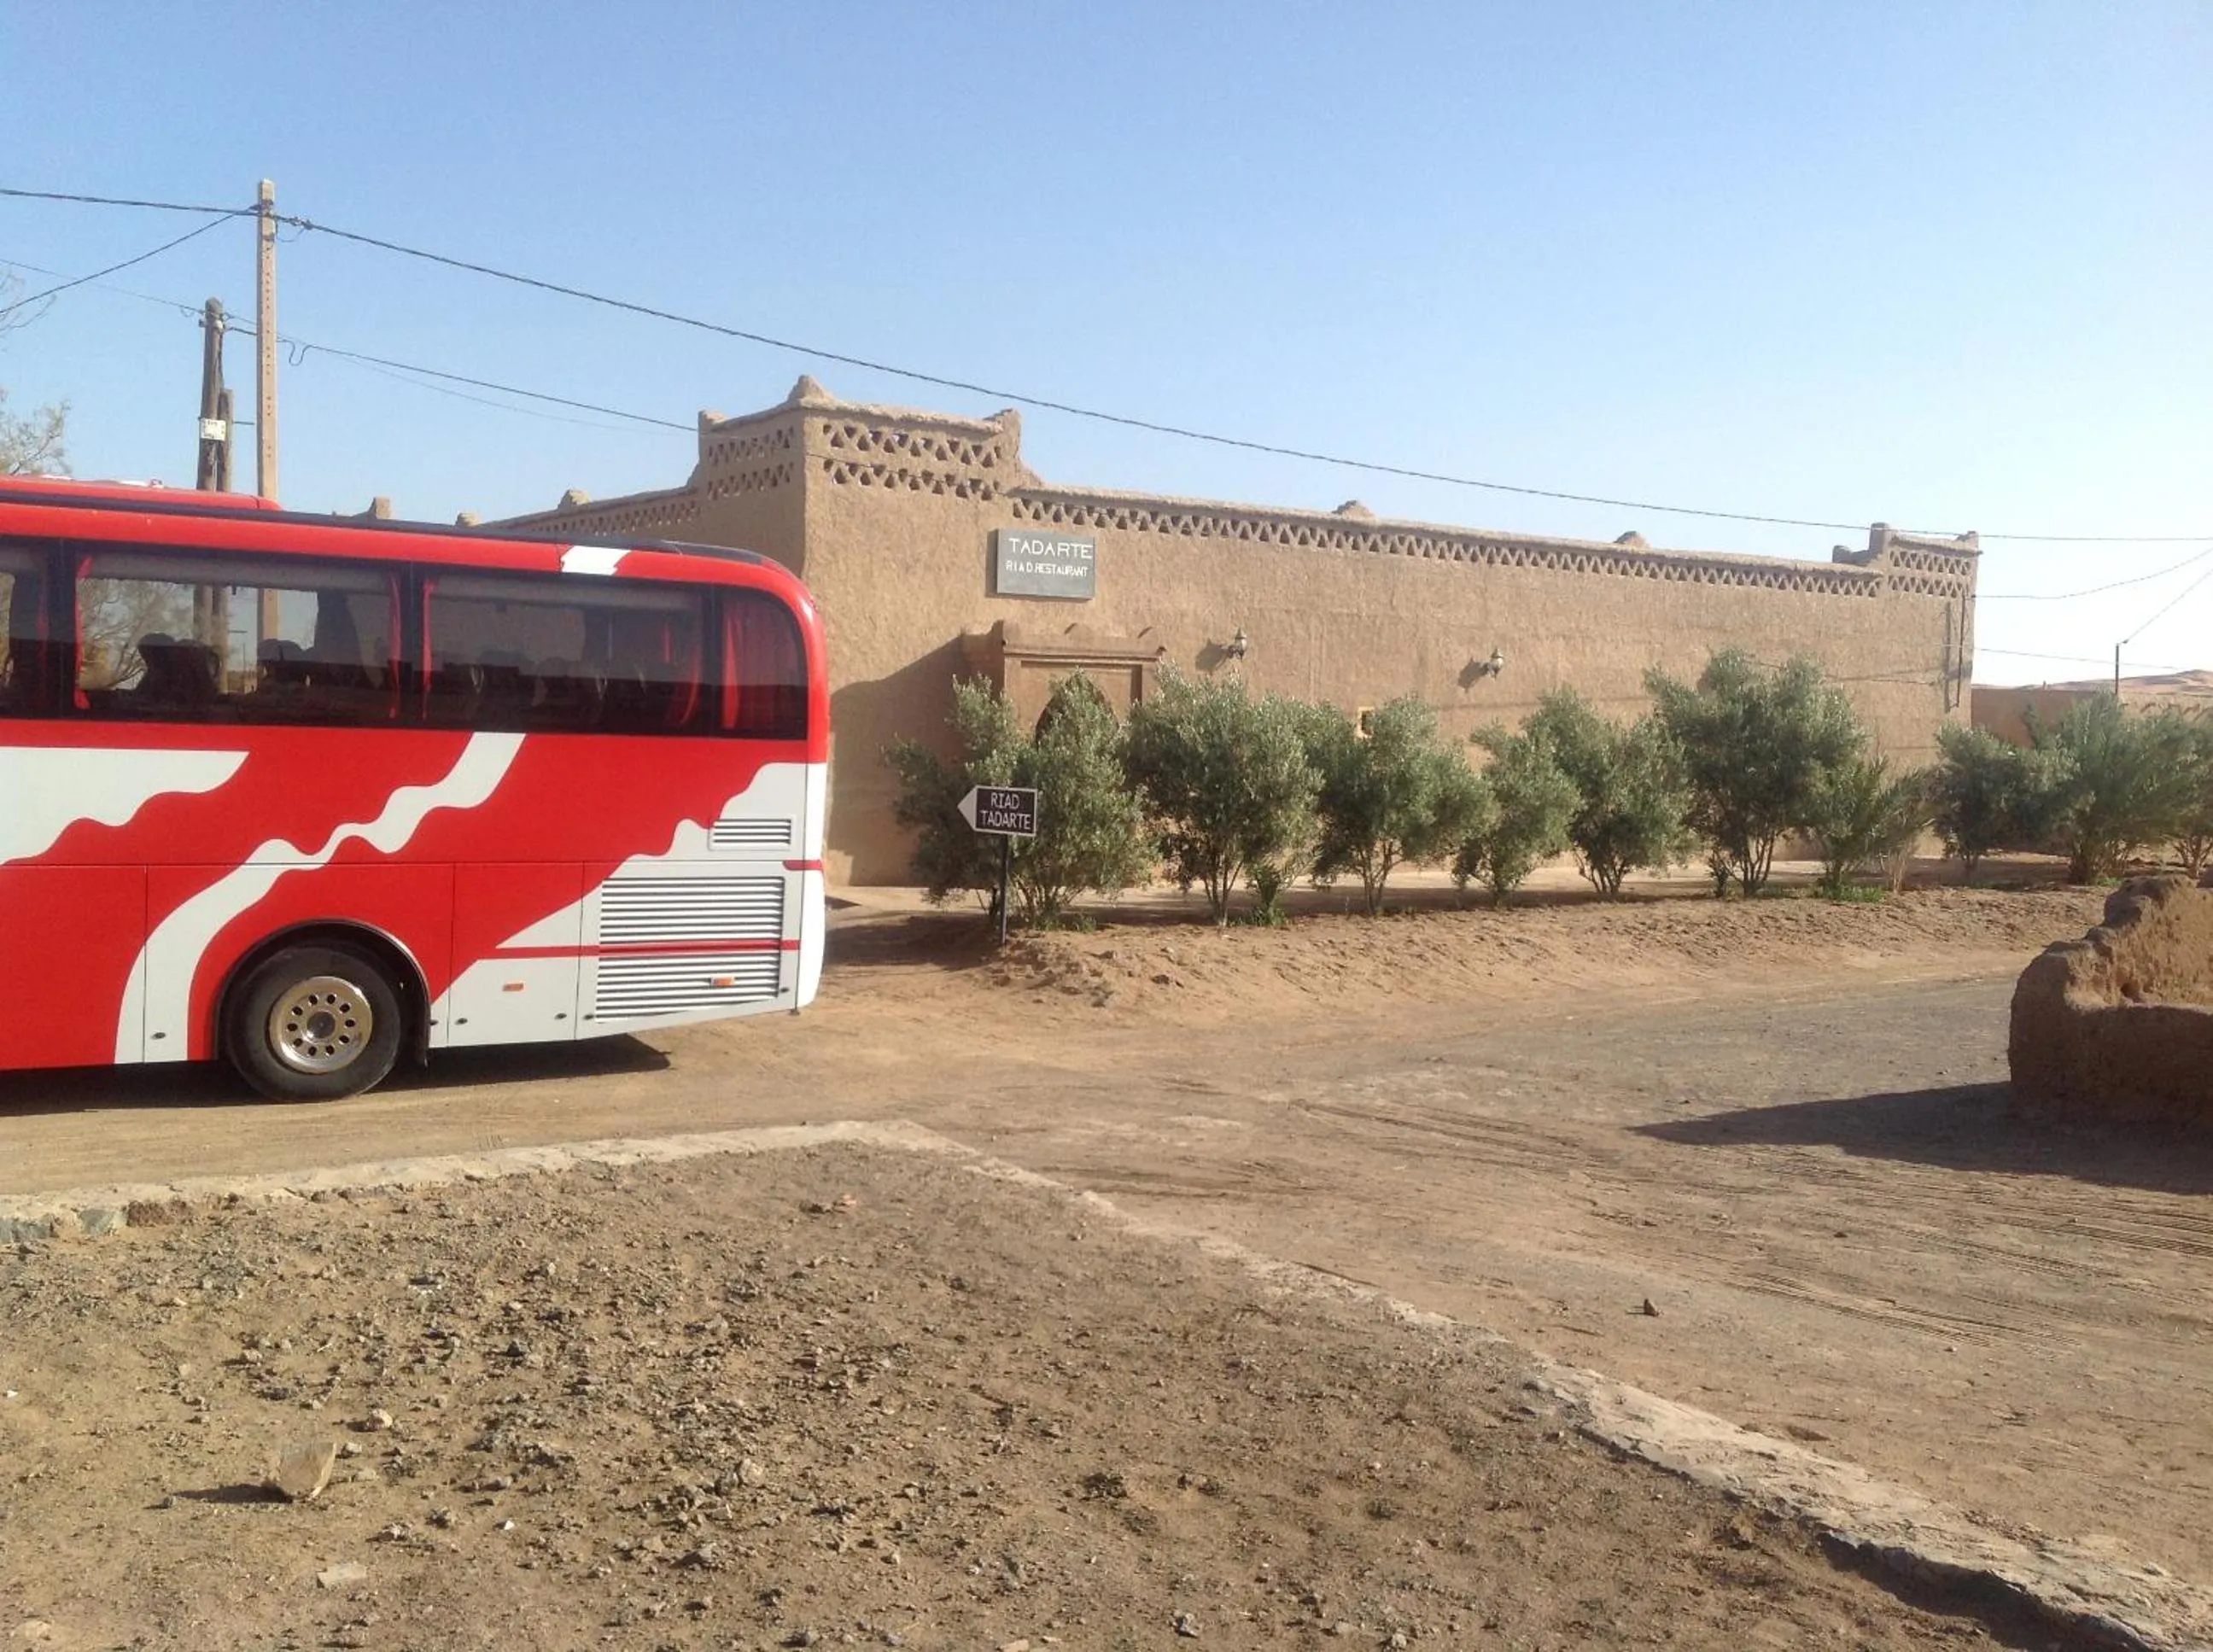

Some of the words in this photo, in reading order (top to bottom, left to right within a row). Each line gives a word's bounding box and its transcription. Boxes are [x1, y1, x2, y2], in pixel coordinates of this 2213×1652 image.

[1008, 537, 1093, 559] TADARTE
[1006, 560, 1033, 574] RIAD
[1035, 563, 1089, 577] RESTAURANT
[990, 791, 1020, 809] RIAD
[979, 809, 1031, 830] TADARTE
